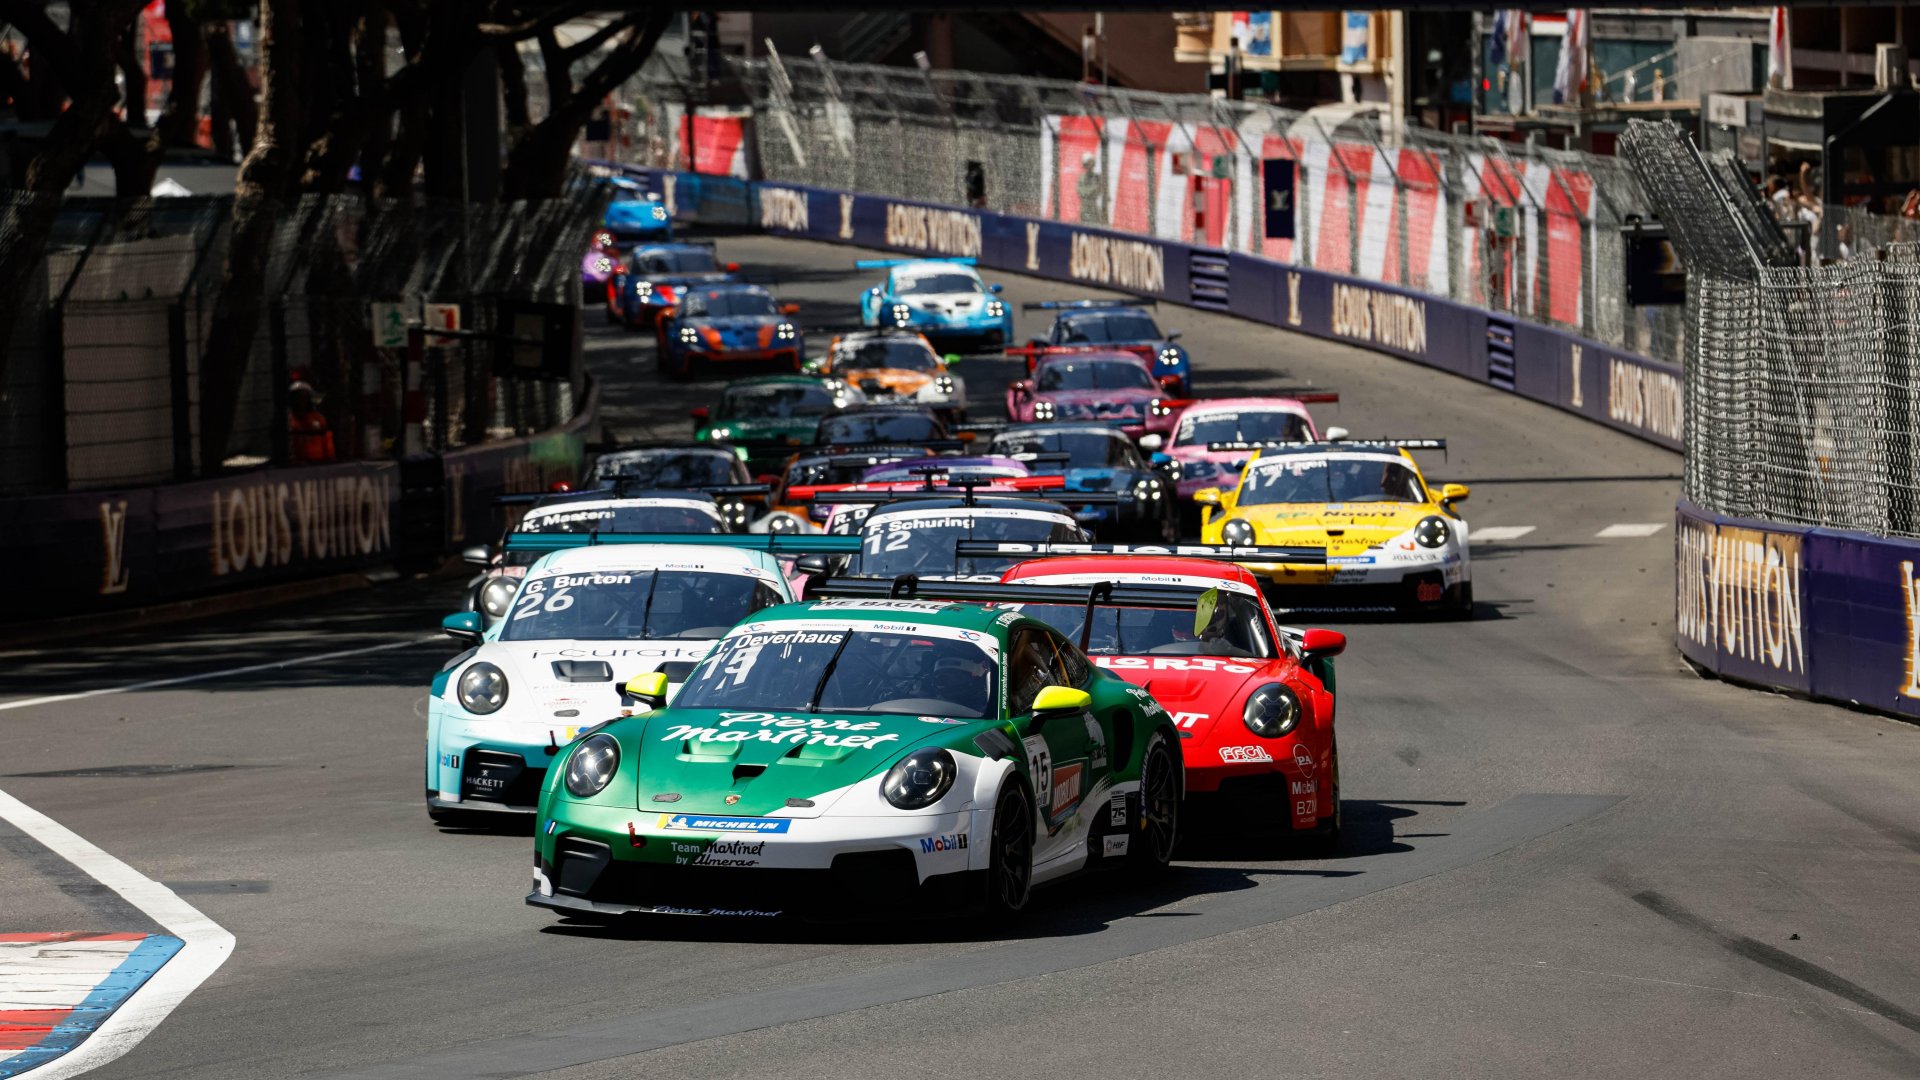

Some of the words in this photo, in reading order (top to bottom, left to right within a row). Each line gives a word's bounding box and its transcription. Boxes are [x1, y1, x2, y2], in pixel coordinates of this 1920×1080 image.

[886, 202, 929, 250] LOUIS
[927, 207, 983, 258] VUITTON
[1069, 231, 1110, 283] LOUIS
[1108, 237, 1165, 291] VUITTON
[1331, 282, 1372, 341] LOUIS
[1371, 288, 1428, 354] VUITTON
[1609, 357, 1643, 428] LOUIS
[211, 484, 293, 576] LOUIS
[296, 474, 392, 561] VUITTON
[543, 509, 616, 527] Masters
[868, 523, 885, 536] F.
[889, 517, 975, 532] Schuring
[864, 531, 911, 556] 12
[525, 580, 548, 594] G.
[553, 574, 632, 590] Burton
[514, 586, 575, 621] 26
[1677, 523, 1708, 648] LOUIS
[1708, 534, 1805, 675] VUITTON
[873, 623, 905, 632] Mobil
[714, 640, 730, 655] T.
[719, 712, 882, 732] Pierre
[661, 724, 899, 750] Martinet
[466, 776, 505, 788] HACKETT
[1033, 751, 1049, 795] 15
[1111, 807, 1126, 819] 75
[692, 820, 780, 831] MICHELIN
[671, 842, 700, 854] Team
[703, 838, 766, 857] Martinet
[920, 834, 957, 854] Mobil
[957, 833, 968, 850] 1
[1112, 841, 1127, 849] HIF
[676, 855, 689, 866] by
[692, 853, 760, 867] Almeras
[652, 905, 703, 916] Pierre
[708, 907, 783, 917] Martinet
